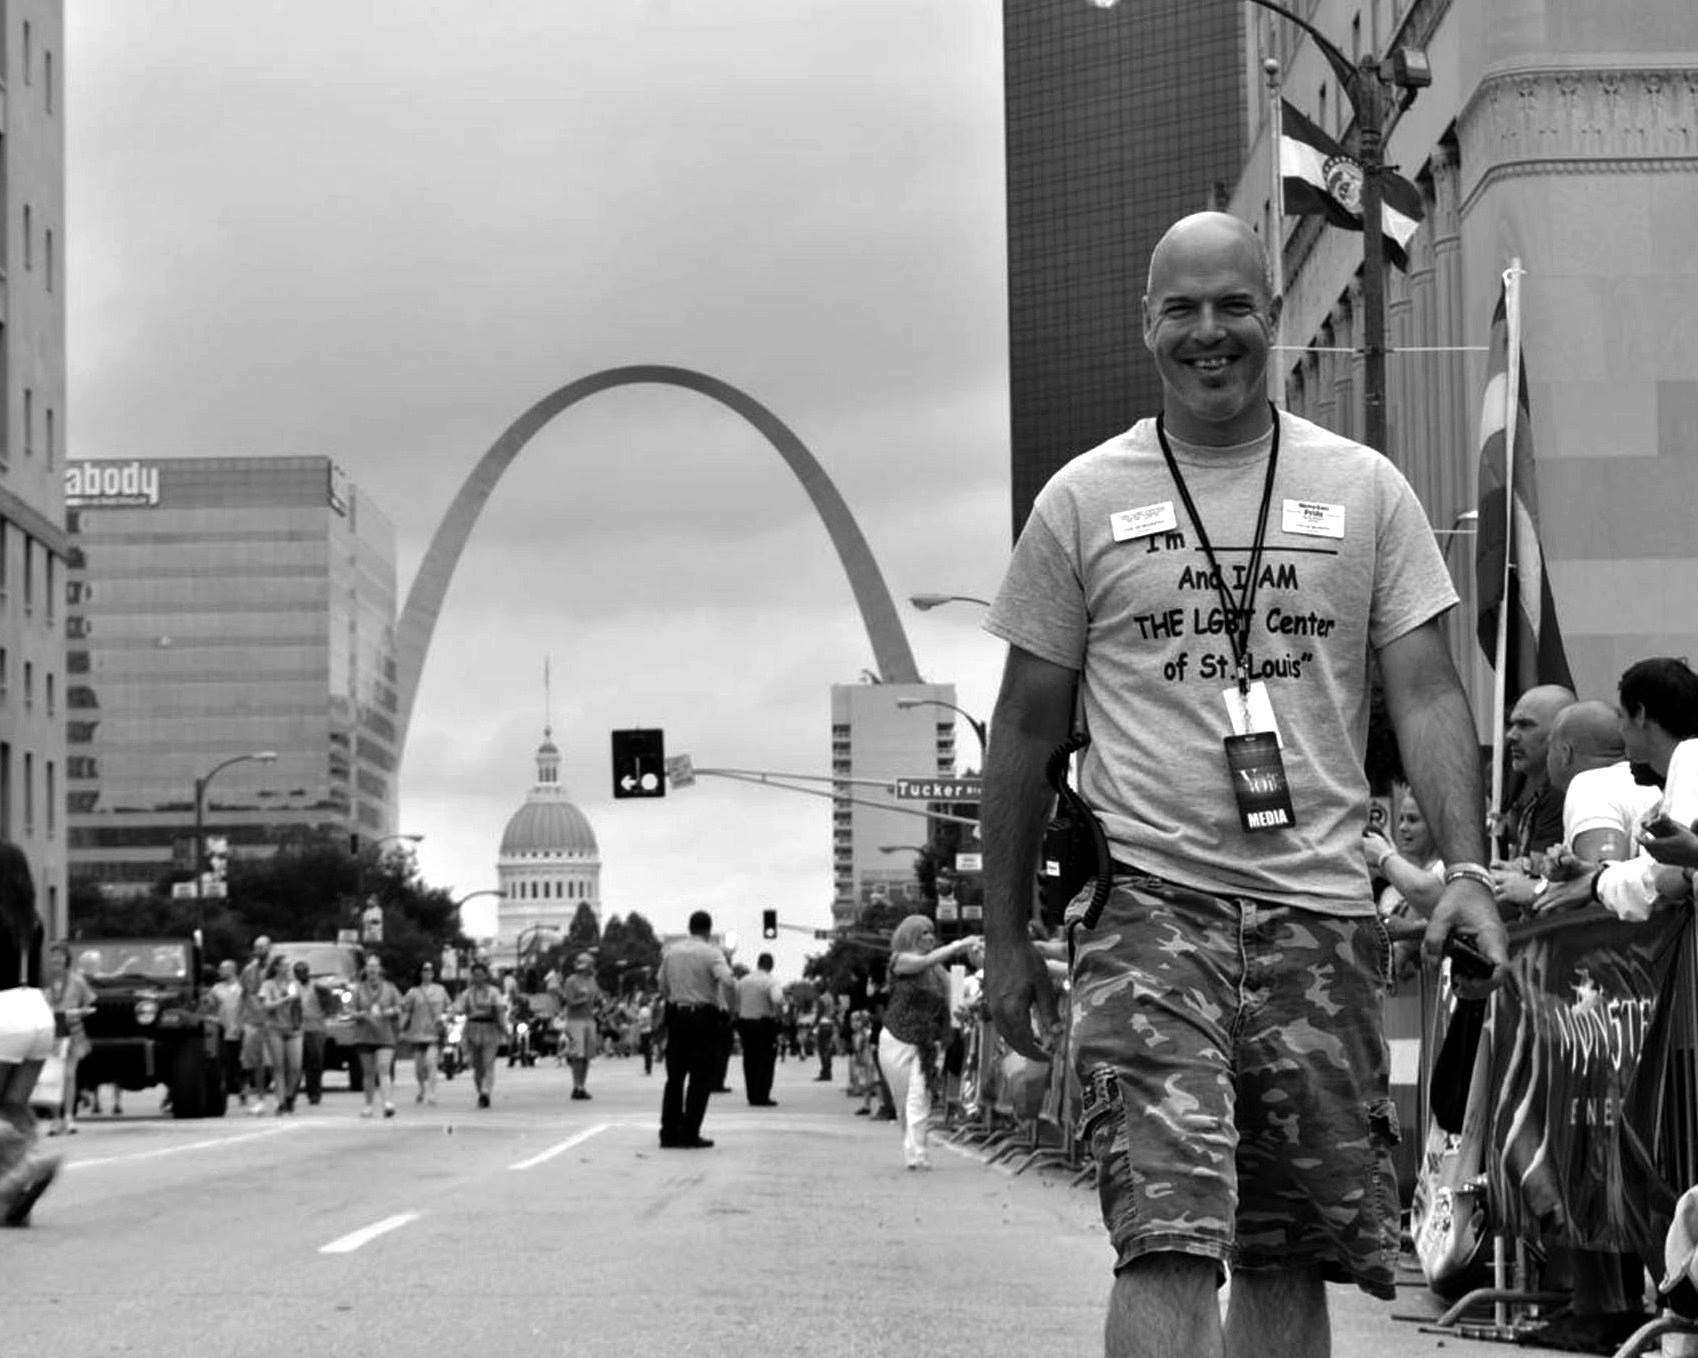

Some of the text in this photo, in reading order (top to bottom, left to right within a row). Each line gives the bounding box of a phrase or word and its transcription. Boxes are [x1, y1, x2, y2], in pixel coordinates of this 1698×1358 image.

[65, 461, 159, 505] abody
[1178, 564, 1298, 590] And I AM
[1134, 608, 1184, 640] THE
[1266, 607, 1335, 638] Center
[1163, 652, 1188, 681] of
[1200, 653, 1236, 680] St.
[899, 781, 962, 797] Tucker
[1247, 808, 1289, 829] MEDIA
[1555, 995, 1657, 1076] MONSTE
